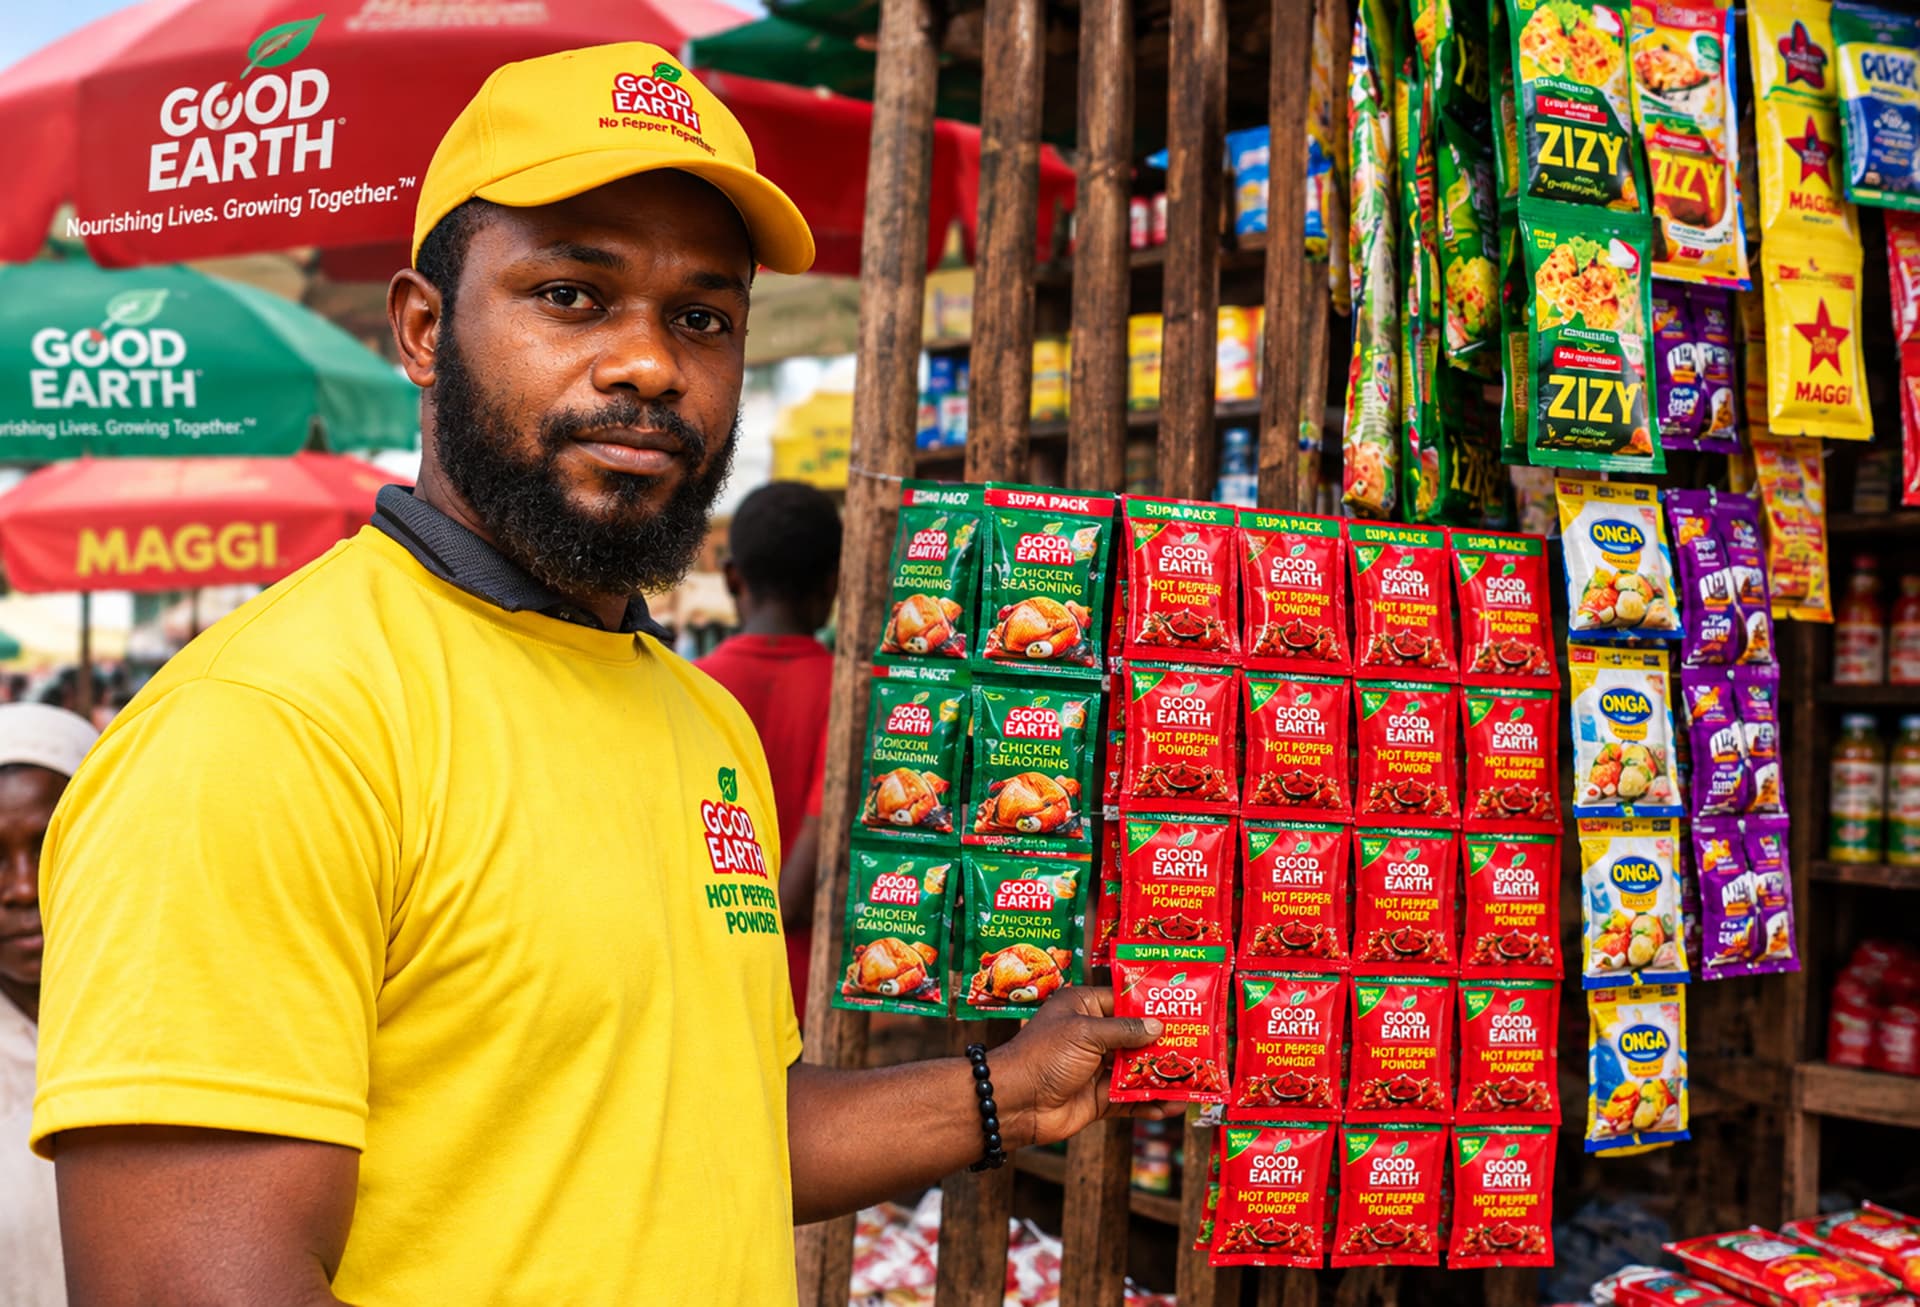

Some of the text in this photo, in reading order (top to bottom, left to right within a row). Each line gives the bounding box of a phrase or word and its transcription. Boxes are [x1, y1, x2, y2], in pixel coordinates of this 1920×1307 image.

[617, 75, 690, 107] GOOD
[160, 69, 329, 136] GOOD
[615, 92, 699, 129] EARTH
[599, 117, 618, 128] No
[148, 119, 335, 192] EARTH
[1535, 122, 1624, 176] ZIZY
[66, 207, 163, 237] Nourishing
[168, 203, 218, 227] Lives.
[223, 193, 302, 220] Growing
[31, 327, 187, 368] GOOD
[30, 369, 197, 409] EARTH
[1795, 381, 1852, 405] MAGGI
[1547, 374, 1642, 425] ZIZY
[60, 420, 102, 436] Lives.
[105, 419, 170, 440] Growing
[1007, 493, 1089, 512] SUPA PACK
[1145, 504, 1180, 517] SUPA
[1592, 524, 1644, 545] ONGA
[76, 523, 278, 576] MAGGI
[1020, 535, 1069, 550] GOOD
[1016, 547, 1073, 565] EARTH
[1161, 545, 1208, 561] GOOD
[1159, 557, 1213, 576] EARTH
[1272, 556, 1317, 571] GOOD
[1013, 567, 1073, 581] CHICKEN
[1270, 569, 1322, 587] EARTH
[1382, 568, 1424, 582] GOOD
[1001, 578, 1082, 596] SEASONING
[1381, 579, 1429, 597] EARTH
[1486, 589, 1532, 605] EARTH
[1160, 697, 1206, 711] GOOD
[1602, 694, 1651, 714] ONGA
[894, 705, 930, 720] GOOD
[1010, 708, 1057, 723] GOOD
[1156, 709, 1212, 727] EARTH
[1276, 707, 1320, 721] GOOD
[887, 717, 932, 734] EARTH
[1005, 720, 1061, 738] EARTH
[1275, 719, 1326, 735] EARTH
[1388, 716, 1430, 730] GOOD
[1494, 722, 1534, 736] GOOD
[1386, 728, 1434, 744] EARTH
[1492, 734, 1538, 751] EARTH
[999, 741, 1061, 756] CHICKEN
[1158, 743, 1208, 757] POWDER
[1265, 739, 1288, 752] HOT
[1377, 750, 1401, 761] HOT
[703, 804, 754, 840] GOOD
[707, 837, 767, 875] EARTH
[1155, 848, 1204, 862] GOOD
[1152, 860, 1208, 878] EARTH
[1275, 856, 1319, 870] GOOD
[1387, 863, 1429, 876] GOOD
[1272, 869, 1323, 884] EARTH
[1495, 868, 1535, 883] GOOD
[1612, 863, 1660, 882] ONGA
[877, 874, 917, 890] GOOD
[1000, 881, 1048, 895] GOOD
[1384, 875, 1433, 891] EARTH
[1493, 881, 1539, 896] EARTH
[705, 884, 738, 908] HOT
[871, 887, 917, 905] EARTH
[1141, 883, 1216, 897] HOT PEPPER
[996, 893, 1051, 910] EARTH
[1262, 892, 1286, 904] HOT
[1375, 898, 1398, 909] HOT
[1485, 903, 1508, 914] HOT
[980, 925, 1061, 940] SEASONING
[1174, 947, 1206, 959] PACK
[1148, 988, 1197, 1001] GOOD
[1145, 1000, 1202, 1016] EARTH
[1271, 1007, 1316, 1021] GOOD
[1384, 1012, 1426, 1025] GOOD
[1491, 1015, 1532, 1029] GOOD
[1267, 1020, 1320, 1036] EARTH
[1381, 1025, 1430, 1039] EARTH
[1489, 1028, 1537, 1043] EARTH
[1256, 1043, 1281, 1054] HOT
[1621, 1032, 1669, 1052] ONGA
[1371, 1047, 1395, 1058] HOT
[1253, 1156, 1299, 1170] GOOD
[1372, 1158, 1415, 1172] GOOD
[1485, 1160, 1527, 1173] GOOD
[1249, 1169, 1303, 1184] EARTH
[1369, 1171, 1420, 1186] EARTH
[1482, 1173, 1531, 1188] EARTH
[1238, 1191, 1263, 1202] HOT
[1359, 1193, 1383, 1204] HOT
[1473, 1195, 1496, 1206] HOT
